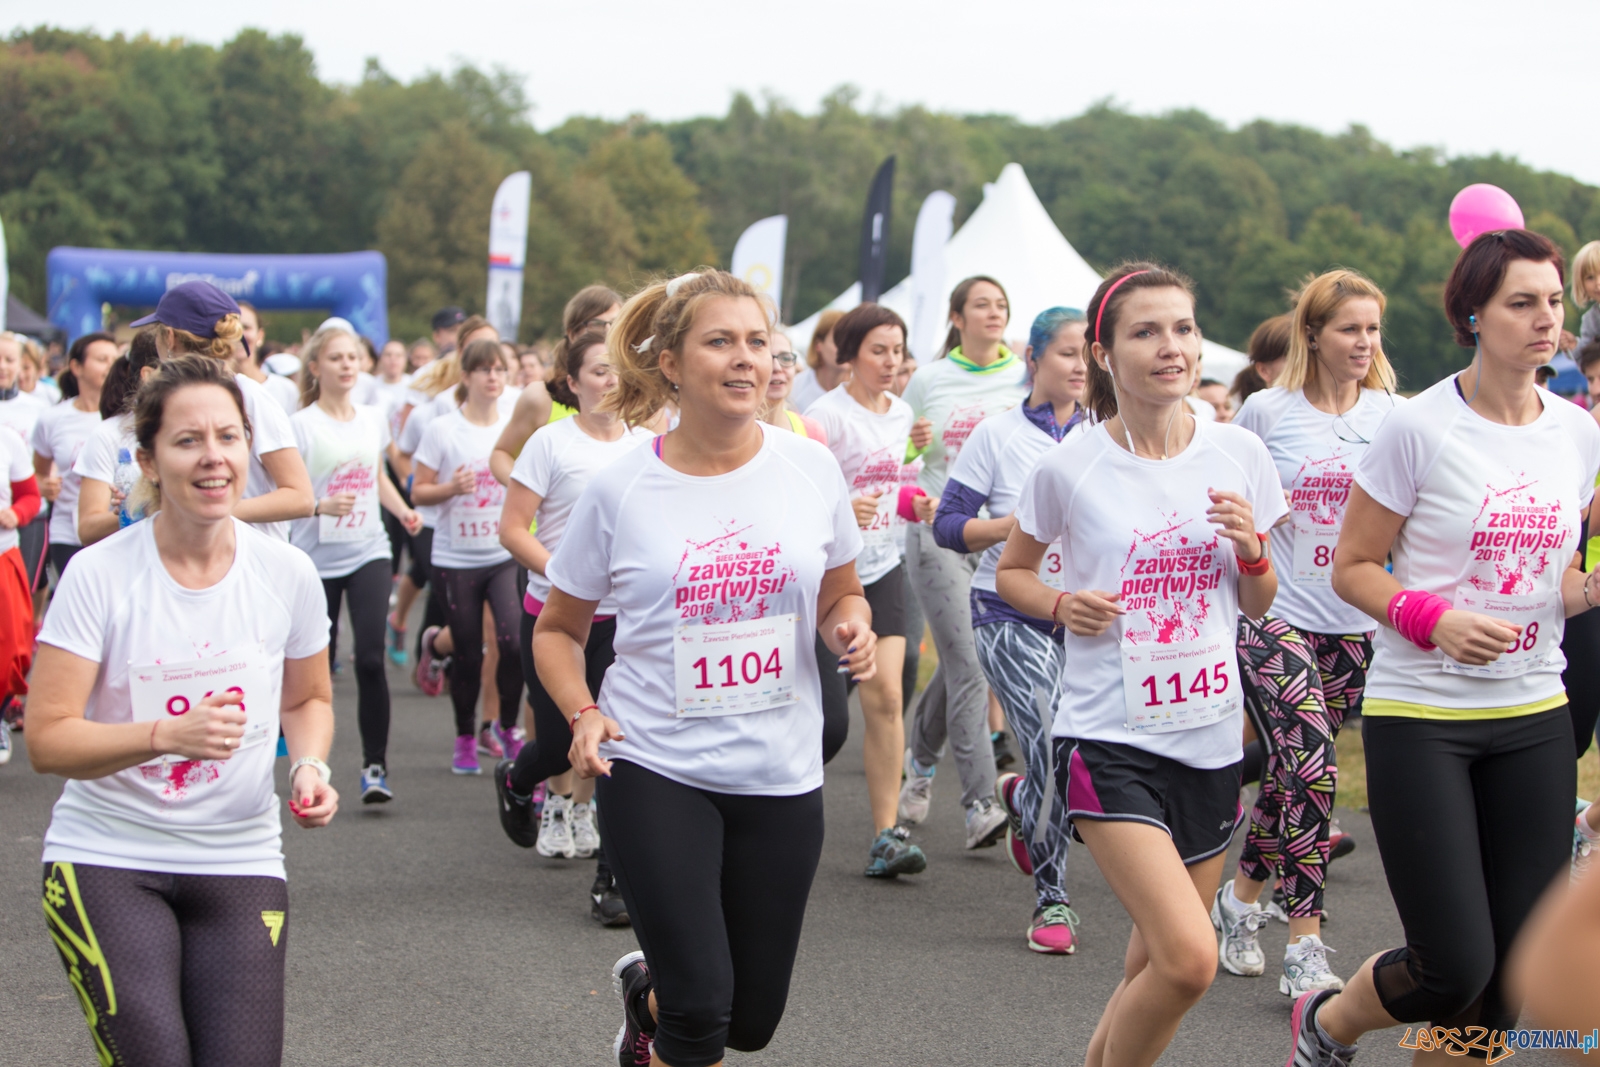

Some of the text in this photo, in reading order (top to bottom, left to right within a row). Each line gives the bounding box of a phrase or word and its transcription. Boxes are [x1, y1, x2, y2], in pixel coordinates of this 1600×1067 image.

[1302, 476, 1353, 489] zawsz
[1291, 488, 1350, 506] pier(w)
[1294, 502, 1319, 511] 2016
[1511, 505, 1548, 514] BIEG KOBIET
[1488, 513, 1558, 530] zawsze
[1469, 529, 1567, 555] pier(w)si!
[715, 551, 764, 563] BIEG KOBIET
[1159, 546, 1203, 557] BIEG KOBIET
[1313, 544, 1337, 567] 8
[1474, 549, 1507, 562] 2016
[688, 558, 775, 582] zawsze
[1133, 553, 1212, 576] zawsze
[675, 573, 788, 609] pier(w)si!
[1120, 568, 1222, 602] pier(w)si!
[680, 602, 715, 619] 2016
[1126, 596, 1157, 611] 2016
[1150, 654, 1177, 662] Zawsze
[1207, 644, 1221, 653] 2016
[162, 672, 193, 682] Zawsze
[228, 661, 247, 673] 2016
[692, 647, 783, 690] 1104
[1141, 661, 1229, 707] 1145
